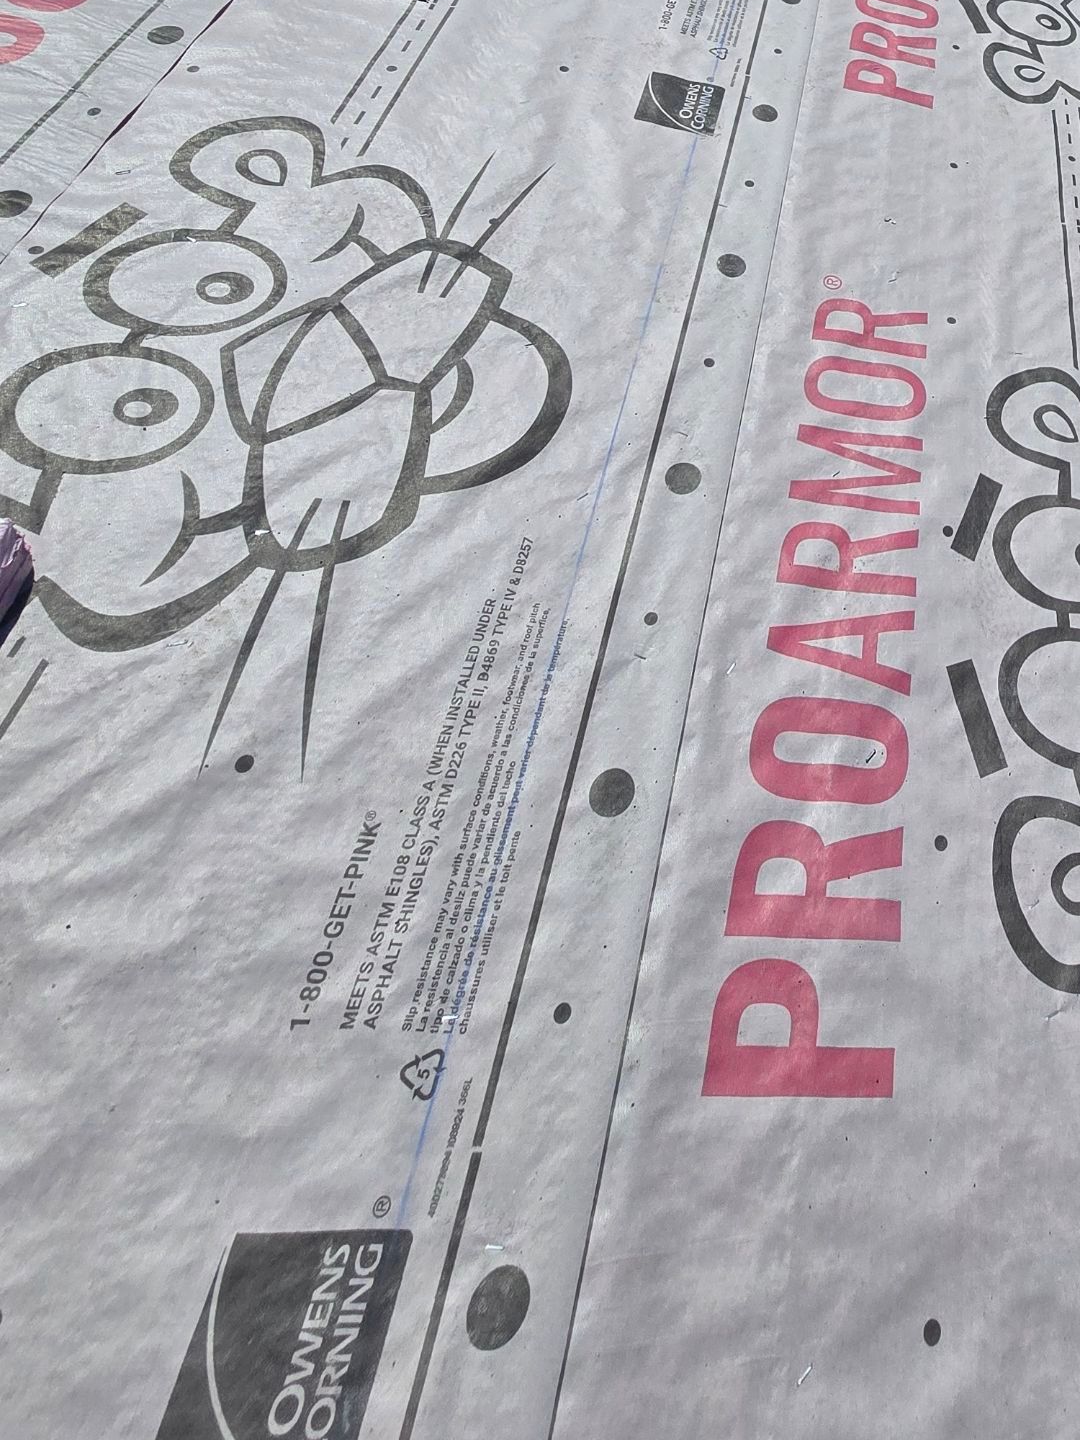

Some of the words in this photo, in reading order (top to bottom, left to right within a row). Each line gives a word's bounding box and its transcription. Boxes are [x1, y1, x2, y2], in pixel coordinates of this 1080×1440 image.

[679, 83, 701, 119] OWENS
[690, 86, 715, 130] CORNING
[512, 536, 534, 573] D8257
[503, 588, 517, 600] IV
[508, 577, 521, 585] &
[471, 599, 496, 641] UNDER
[491, 603, 512, 635] TYPE
[444, 645, 481, 720] INSTALLED
[458, 700, 481, 737] TYPE
[426, 725, 457, 775] (WHEN
[444, 742, 468, 778] D226
[420, 780, 436, 791] A
[427, 784, 454, 830] ASTM
[400, 795, 431, 849] CLASS
[384, 854, 411, 896] E108
[393, 835, 440, 933] SHINGLES),
[364, 902, 395, 955] ASTM
[339, 961, 375, 1029] MEETS
[361, 939, 404, 1029] ASPHALT
[268, 1244, 350, 1437] OWENS
[305, 1243, 384, 1440] ORNING
